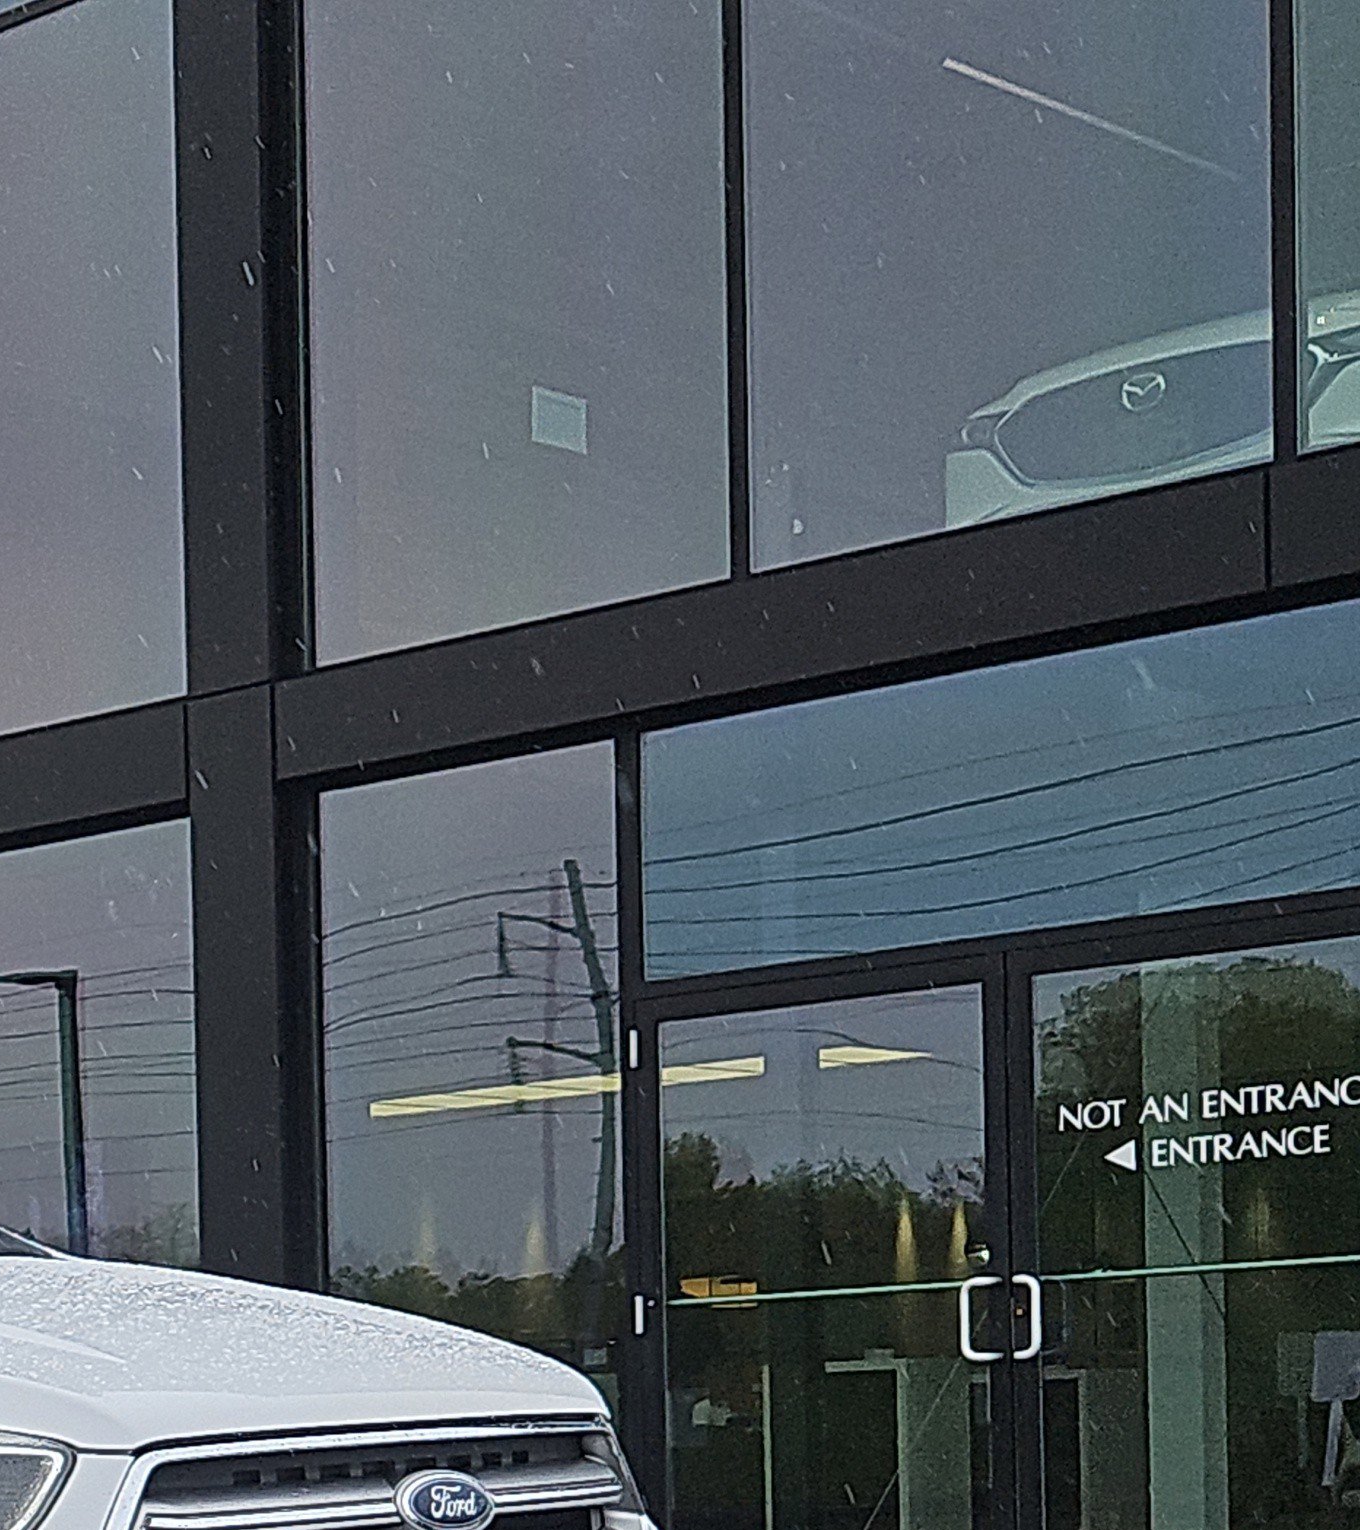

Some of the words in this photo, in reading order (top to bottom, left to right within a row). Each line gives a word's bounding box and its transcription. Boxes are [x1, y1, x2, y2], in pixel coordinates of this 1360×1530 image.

[1058, 1099, 1127, 1132] NOT
[1139, 1092, 1189, 1124] AN
[1202, 1075, 1360, 1119] ENTRANC
[1152, 1124, 1331, 1167] ENTRANCE
[430, 1485, 477, 1519] Ford
